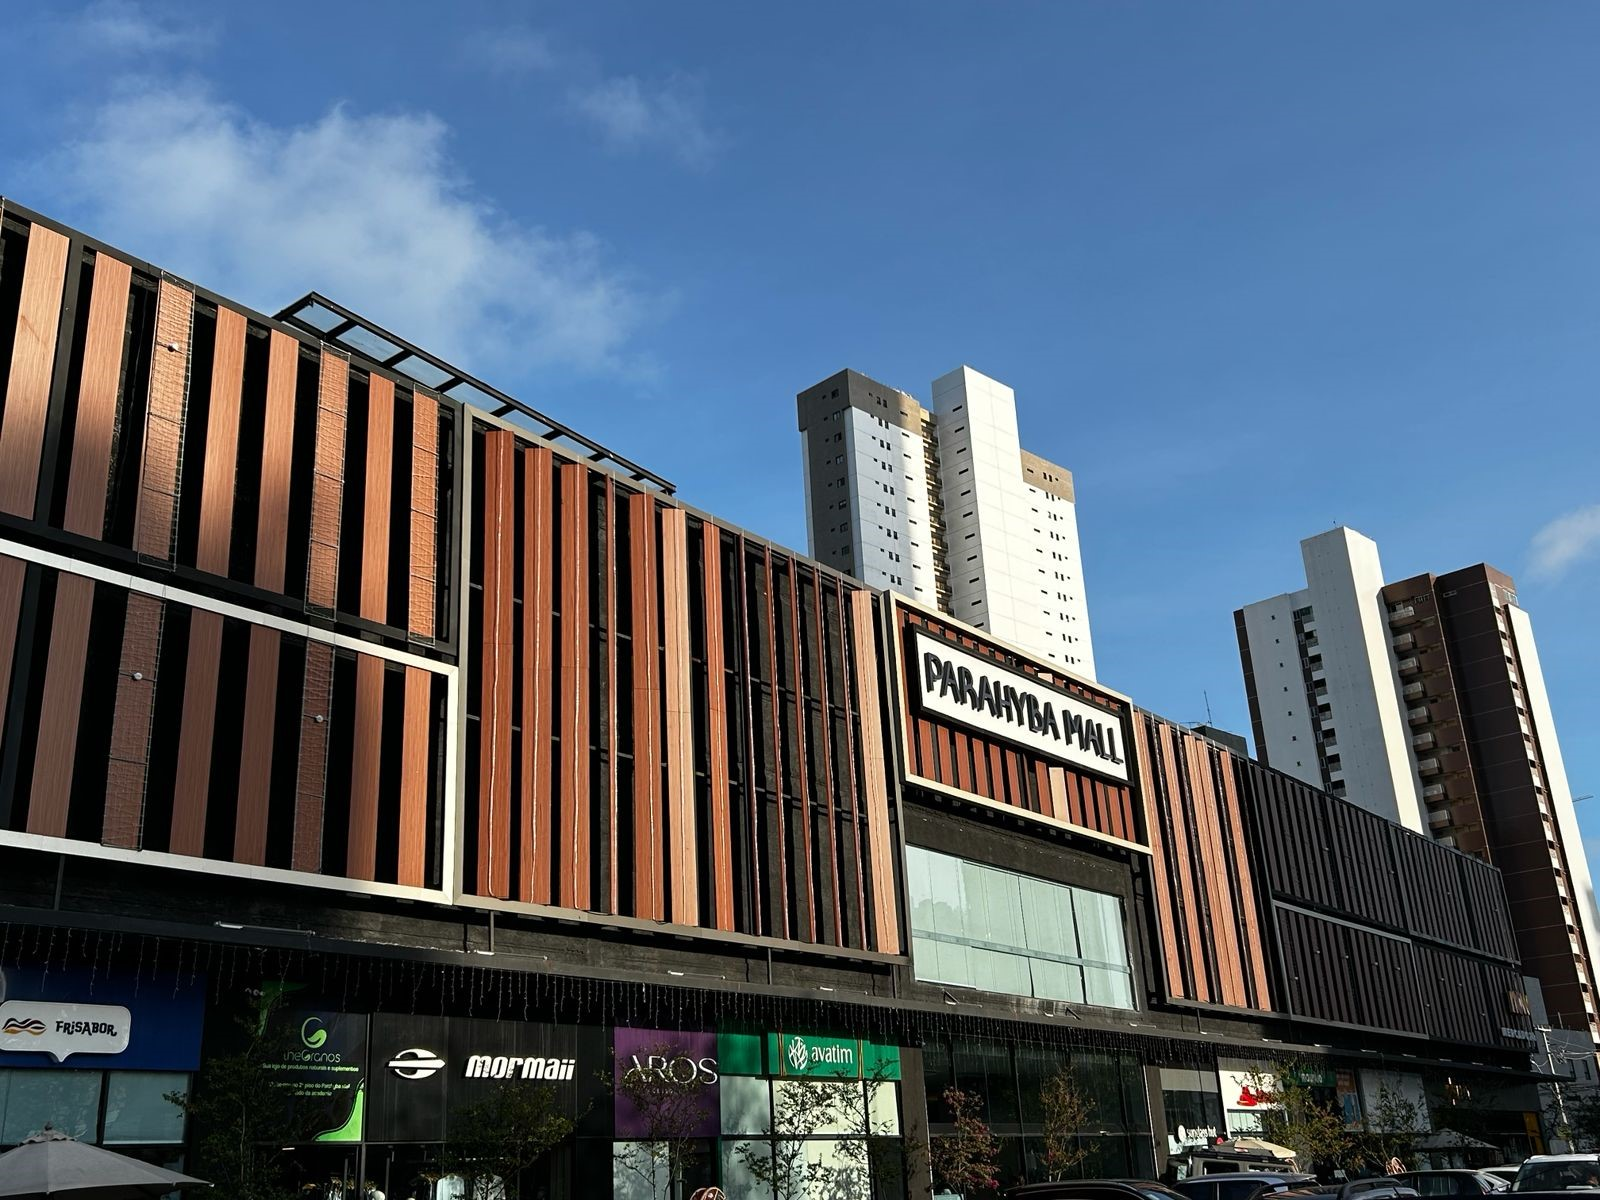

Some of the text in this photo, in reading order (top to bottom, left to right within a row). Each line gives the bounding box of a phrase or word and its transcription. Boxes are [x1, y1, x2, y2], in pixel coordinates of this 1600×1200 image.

[924, 652, 1124, 765] PARAHYBA MALL
[465, 1055, 576, 1081] mormaii
[811, 1044, 853, 1064] avatim
[624, 1054, 718, 1085] AROS
